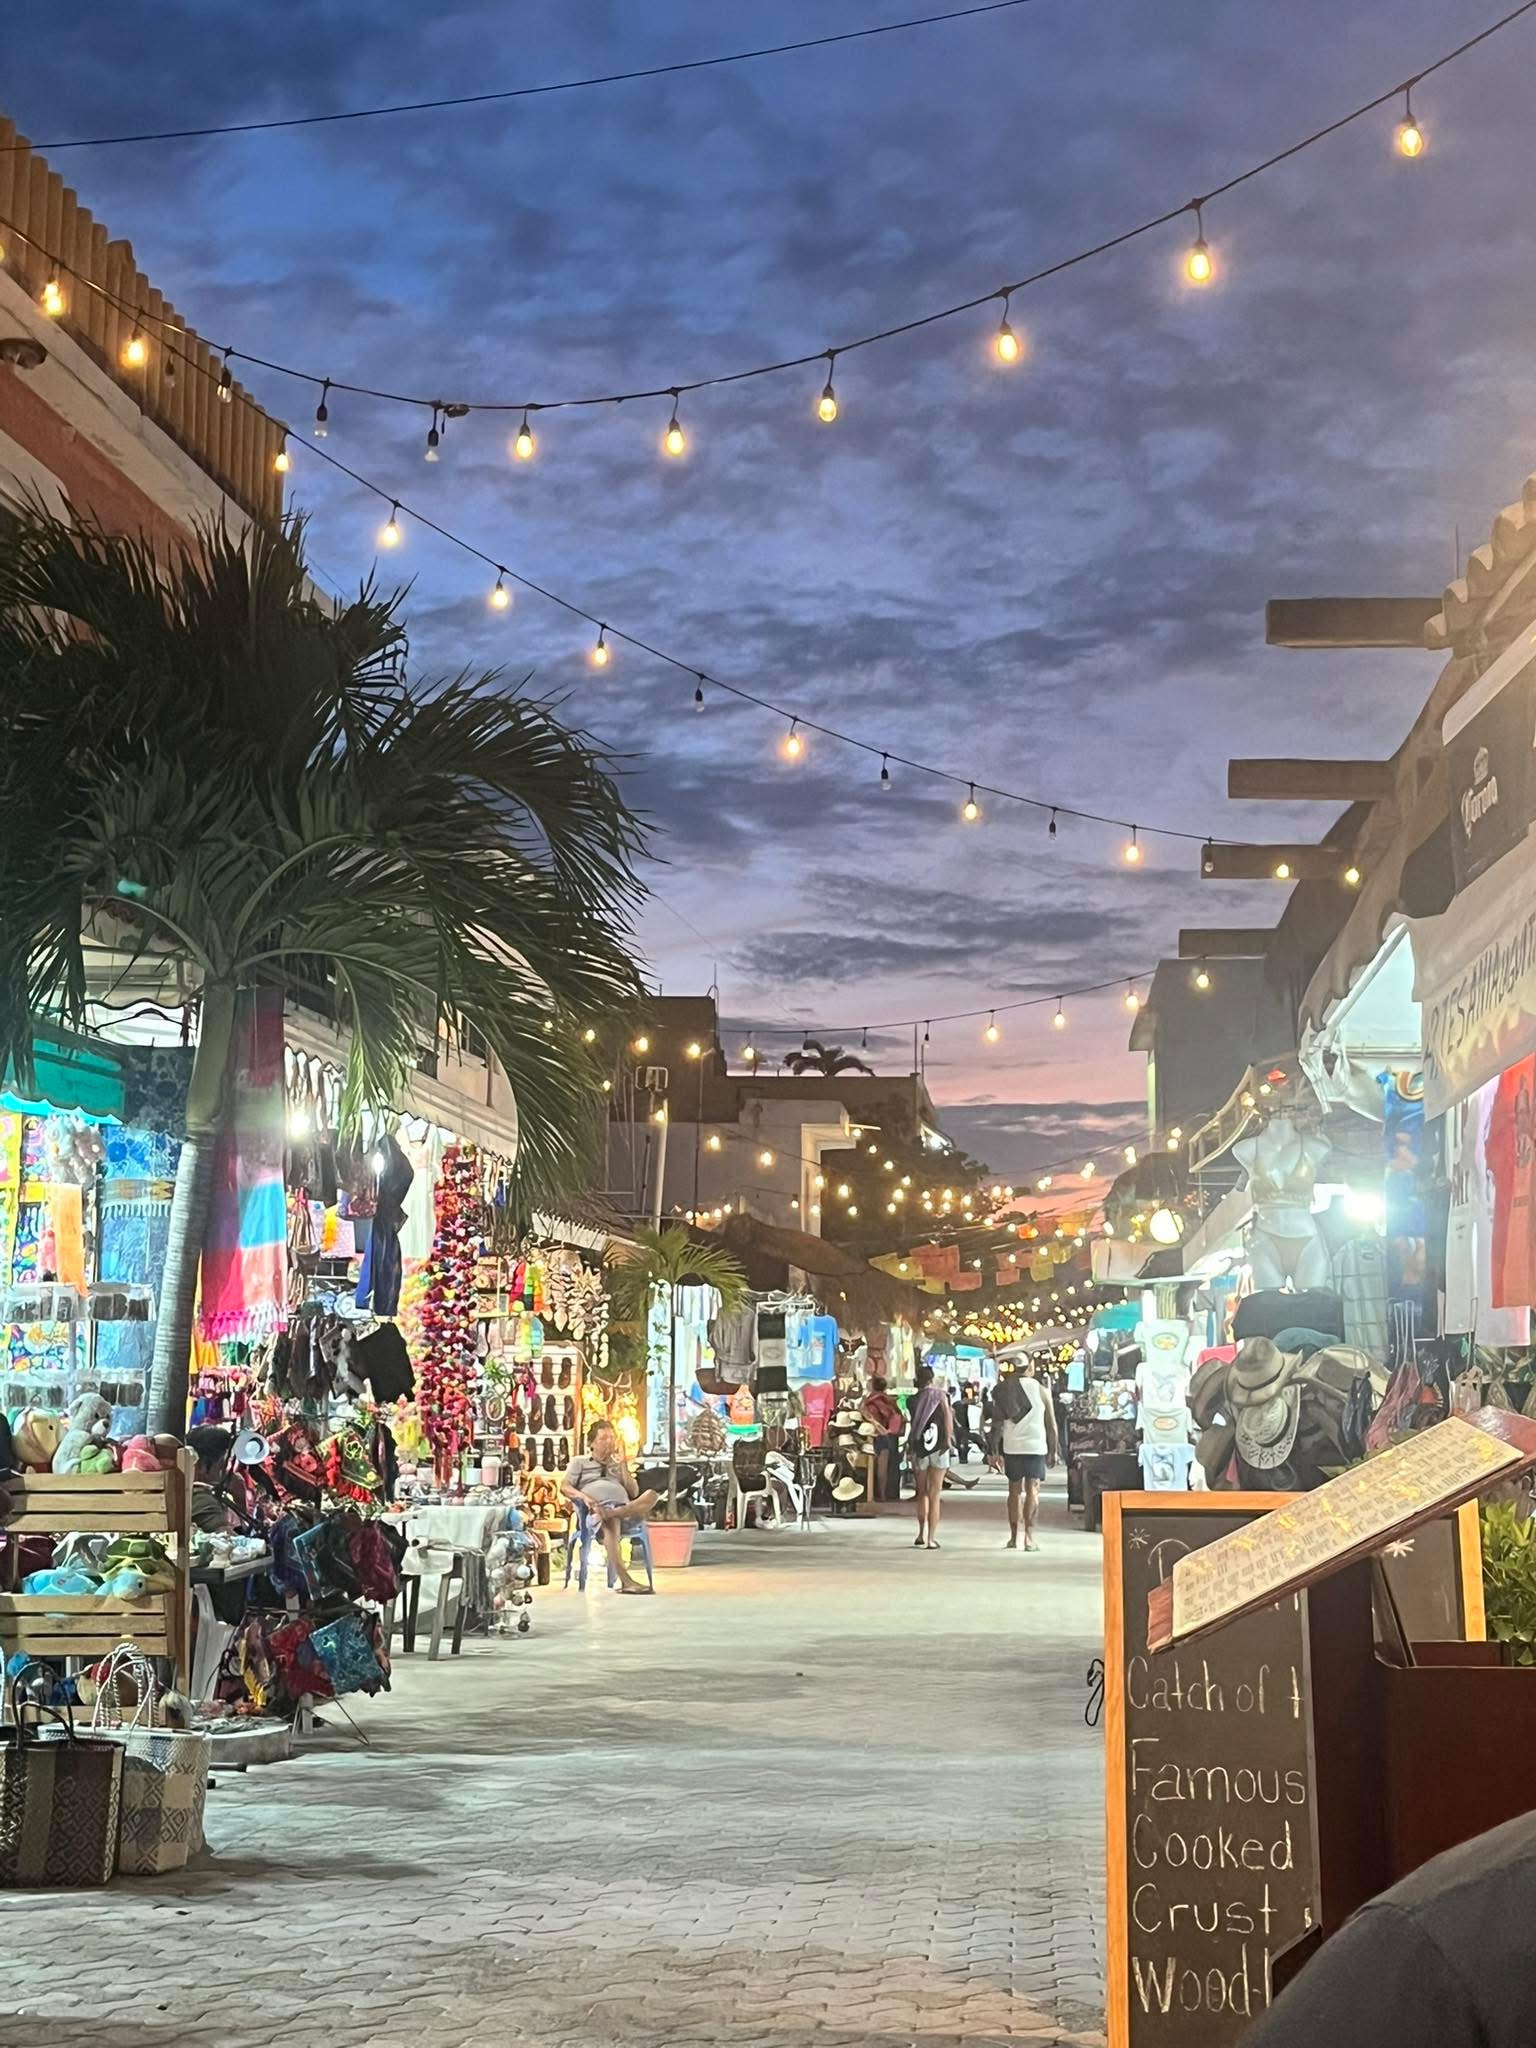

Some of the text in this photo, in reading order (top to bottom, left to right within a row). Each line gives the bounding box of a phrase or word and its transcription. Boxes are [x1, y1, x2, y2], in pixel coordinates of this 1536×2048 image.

[1127, 1656, 1224, 1712] Catch
[1236, 1664, 1270, 1714] of
[1131, 1738, 1306, 1805] Famous
[1132, 1813, 1294, 1870] Cooked
[1132, 1883, 1278, 1935] Crust
